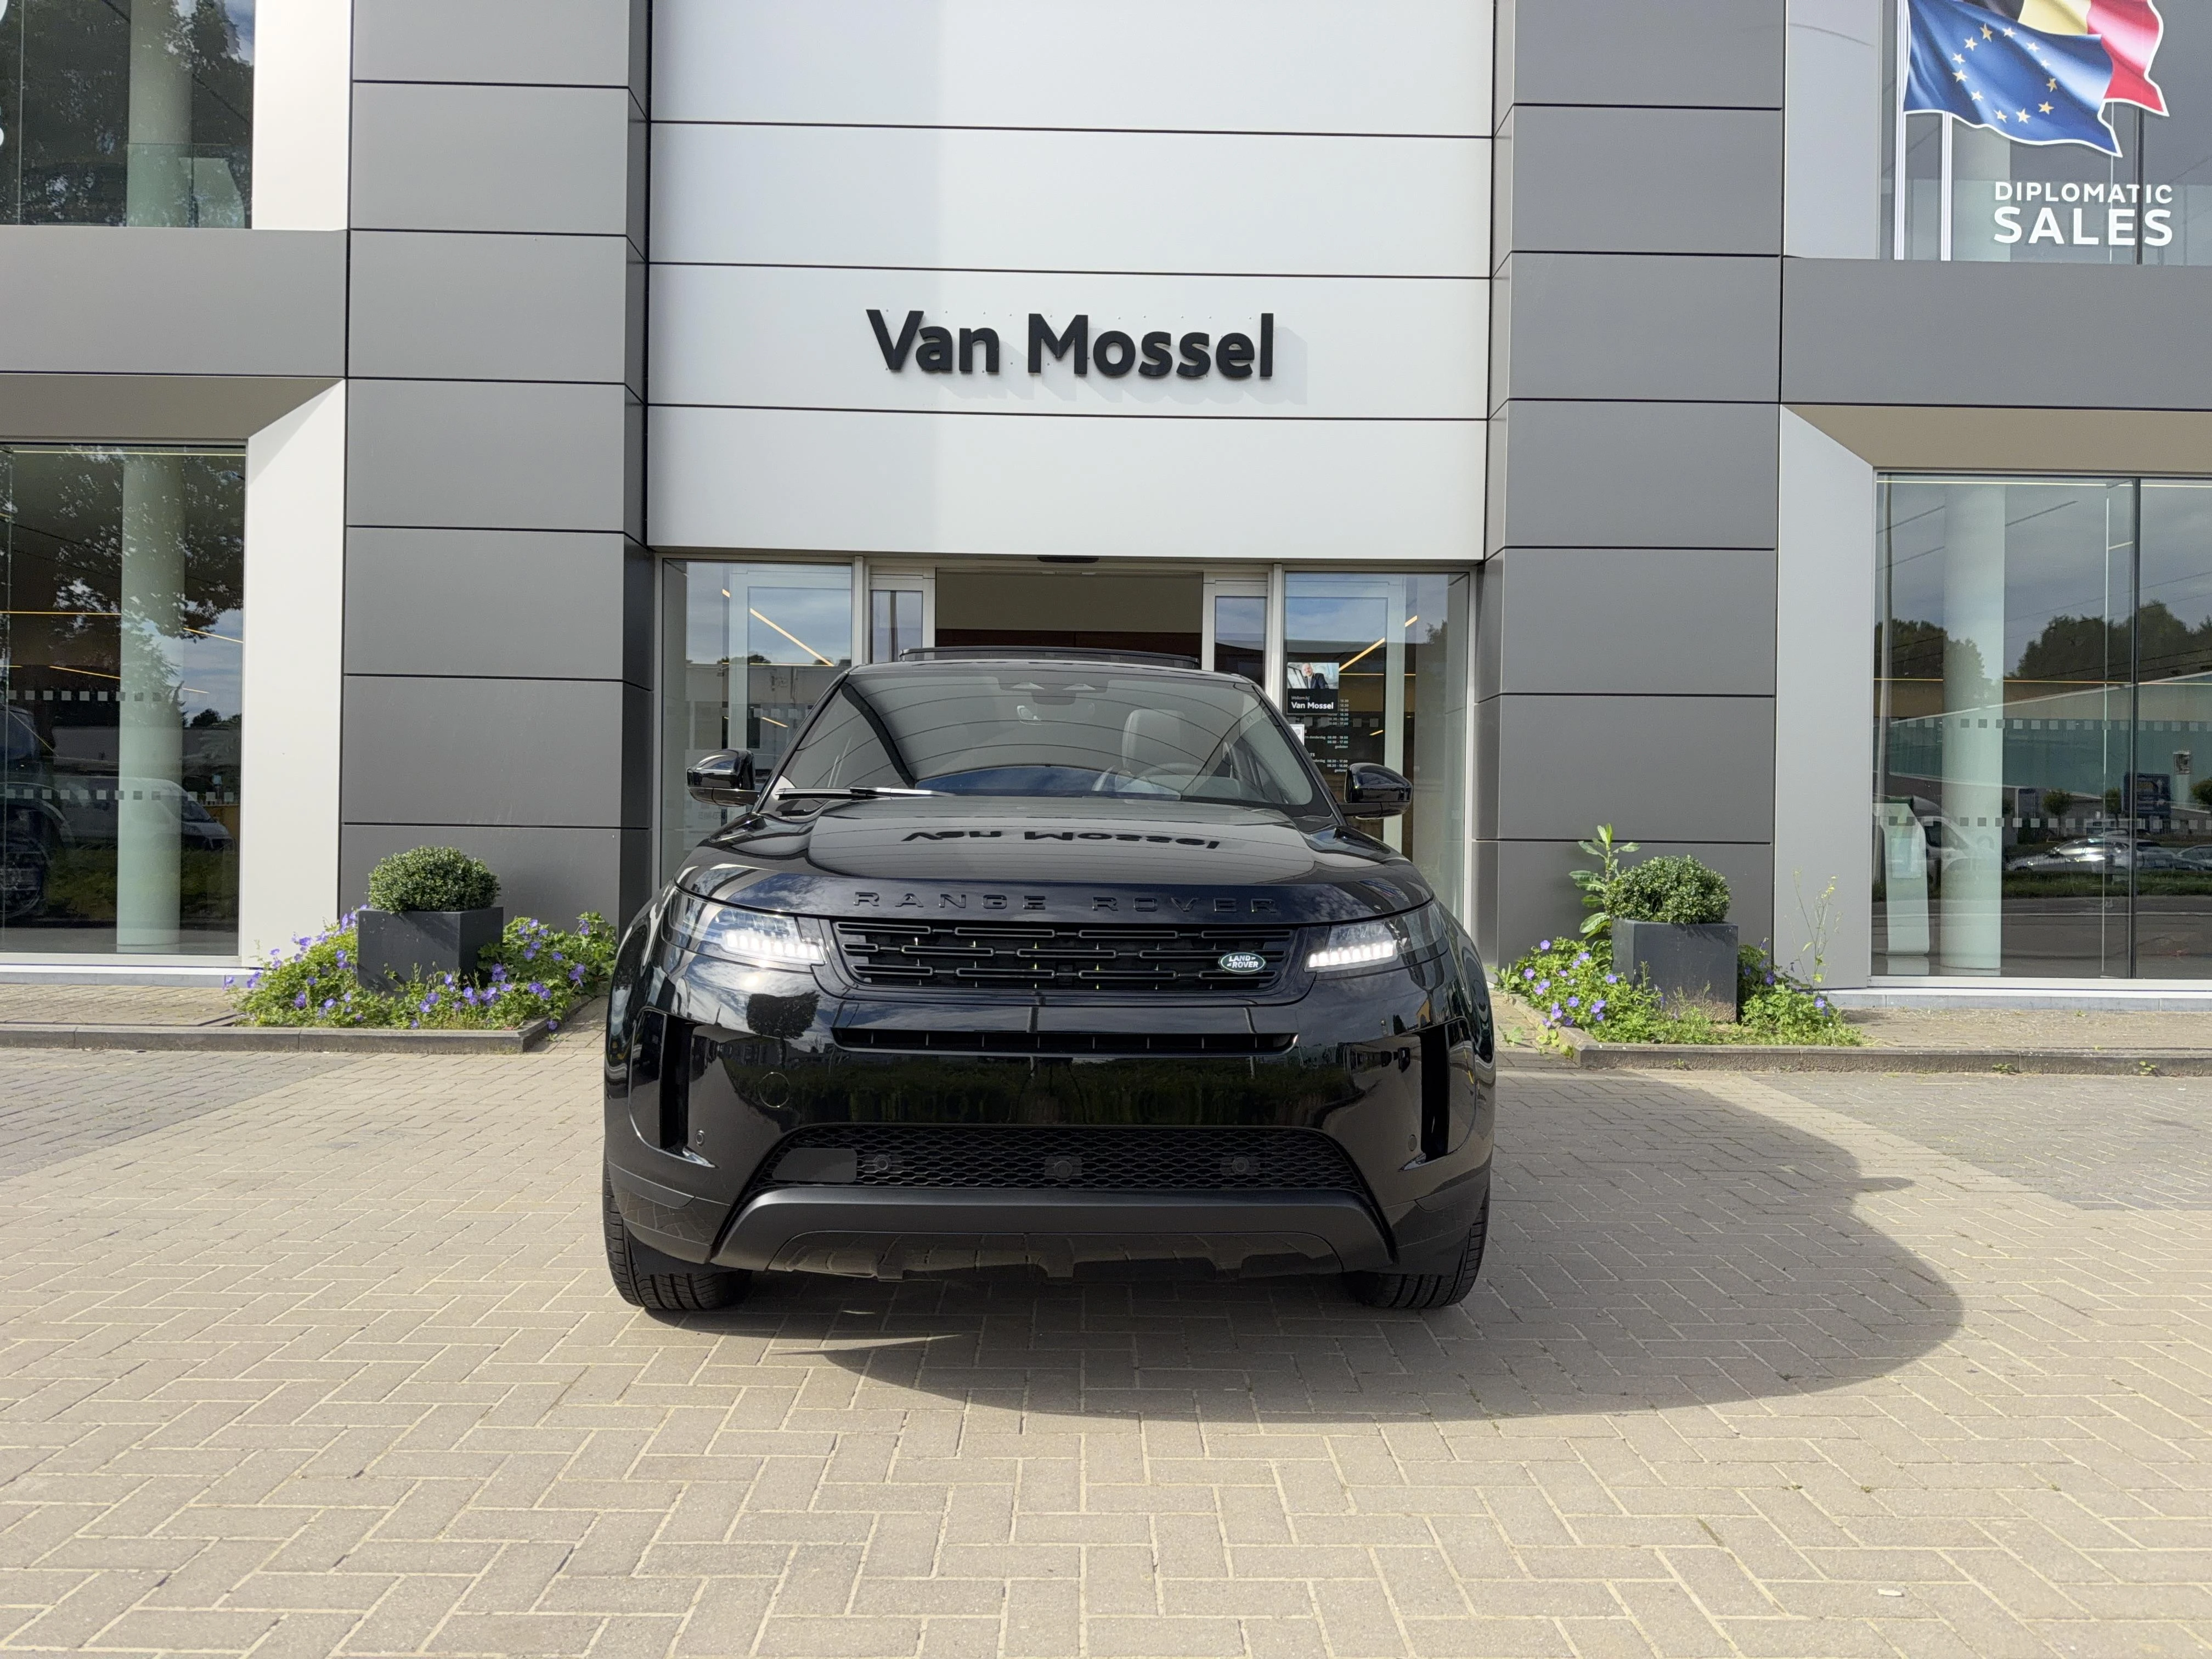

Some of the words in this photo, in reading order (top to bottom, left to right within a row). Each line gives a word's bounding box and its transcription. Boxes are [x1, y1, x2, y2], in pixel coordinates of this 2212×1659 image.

[1995, 182, 2173, 204] DIPLOMATIC
[1993, 206, 2173, 247] SALES
[866, 309, 1000, 373] Van
[1027, 313, 1274, 379] Mossel
[853, 891, 1046, 910] RANGE
[1092, 896, 1277, 913] ROVER
